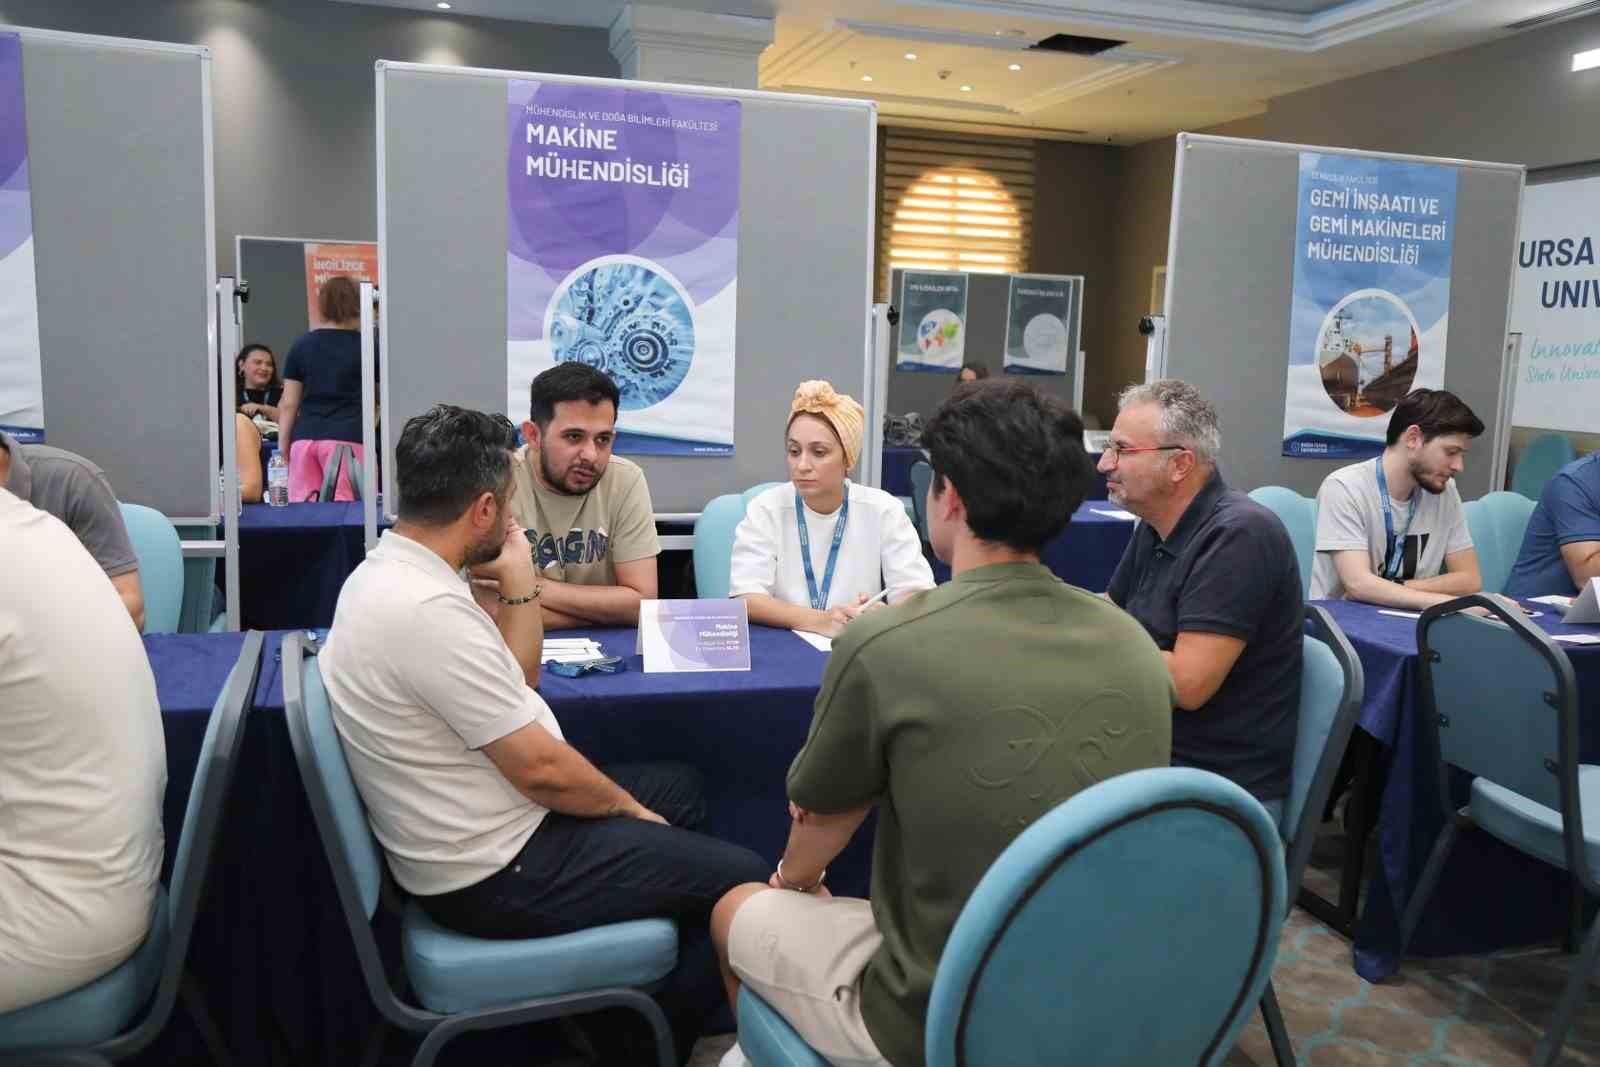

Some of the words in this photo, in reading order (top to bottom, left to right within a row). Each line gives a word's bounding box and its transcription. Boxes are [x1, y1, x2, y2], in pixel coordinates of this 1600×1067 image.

[588, 111, 601, 121] VE
[526, 121, 618, 150] MAKİNE
[526, 152, 690, 188] MÜHENDİSLİĞİ
[1310, 187, 1350, 210] GEMİ
[1353, 187, 1416, 215] İNŞAATI
[1419, 198, 1440, 216] VE
[1310, 213, 1348, 237] GEMİ
[1351, 215, 1447, 241] MAKİNELERİ
[1307, 238, 1420, 265] MÜHENDİSLİĞİ
[1518, 236, 1595, 268] URSA
